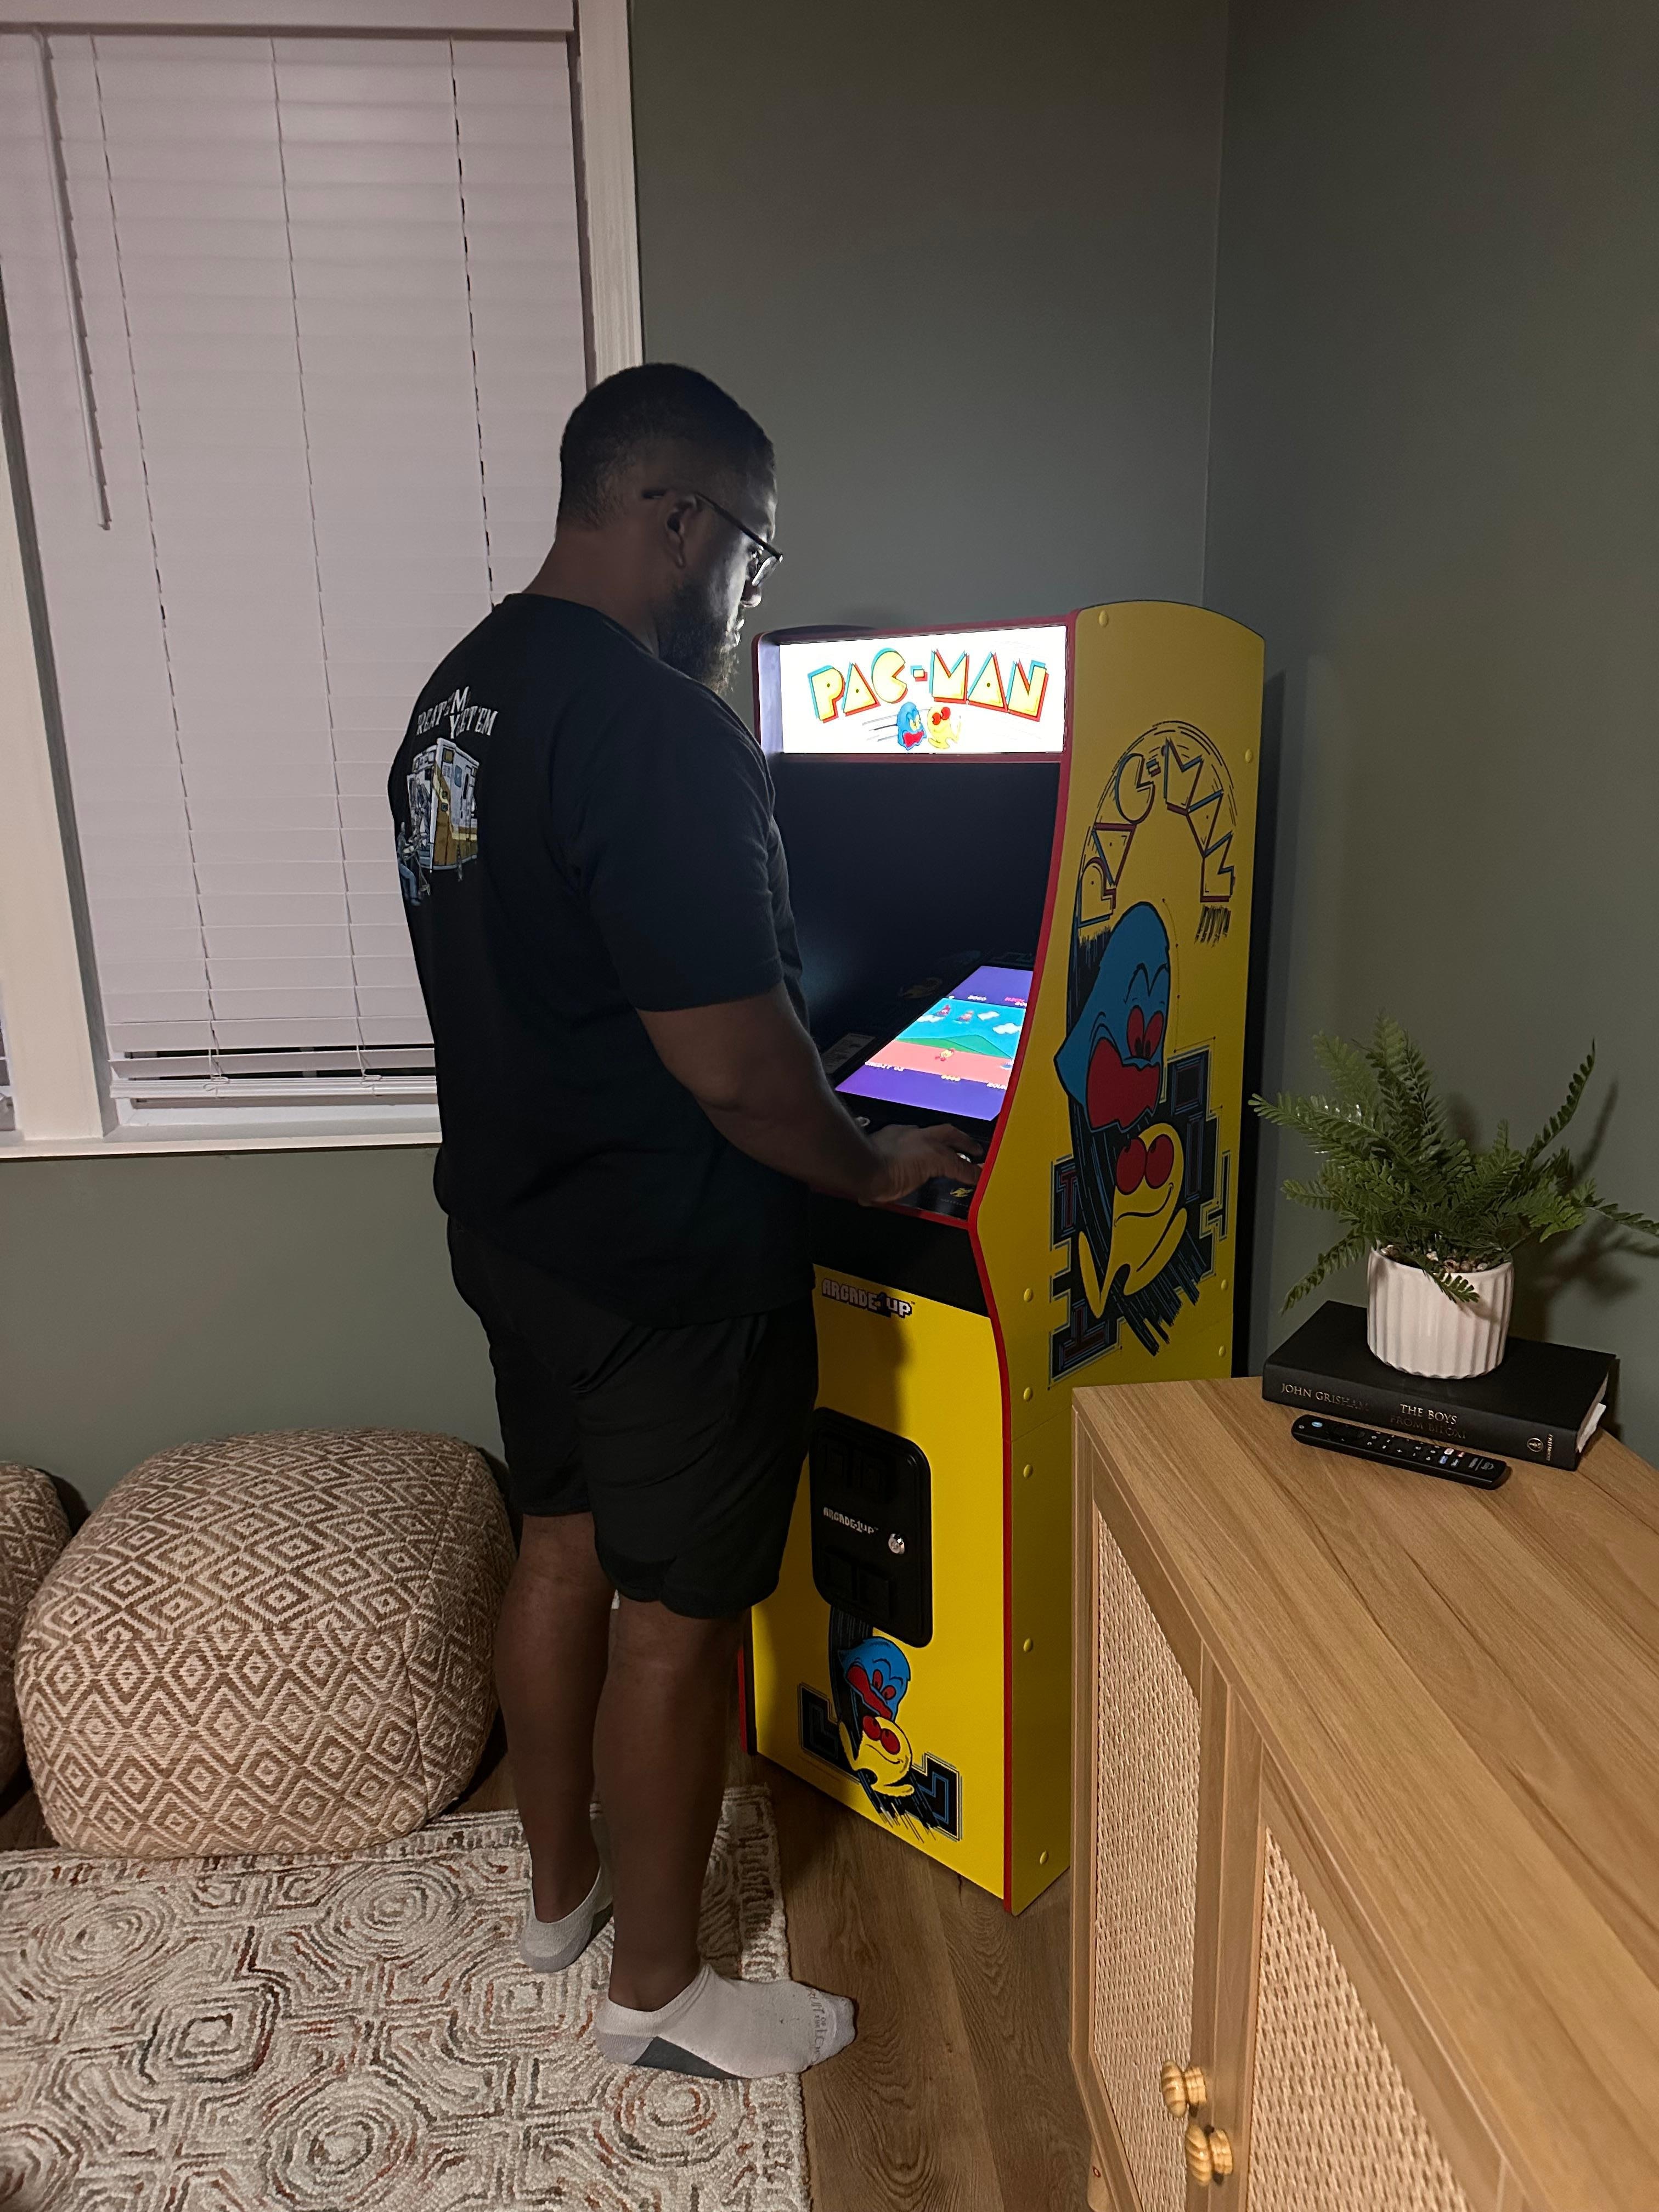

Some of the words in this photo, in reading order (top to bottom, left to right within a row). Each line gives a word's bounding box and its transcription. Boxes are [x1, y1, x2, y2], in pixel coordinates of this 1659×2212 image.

[807, 647, 1049, 723] PAC-MAN
[1280, 1383, 1312, 1398] JOHN
[1400, 1403, 1424, 1418] THE
[1427, 1409, 1458, 1425] BOYS
[1390, 1415, 1424, 1431] FROM
[1428, 1423, 1467, 1440] BILOXI
